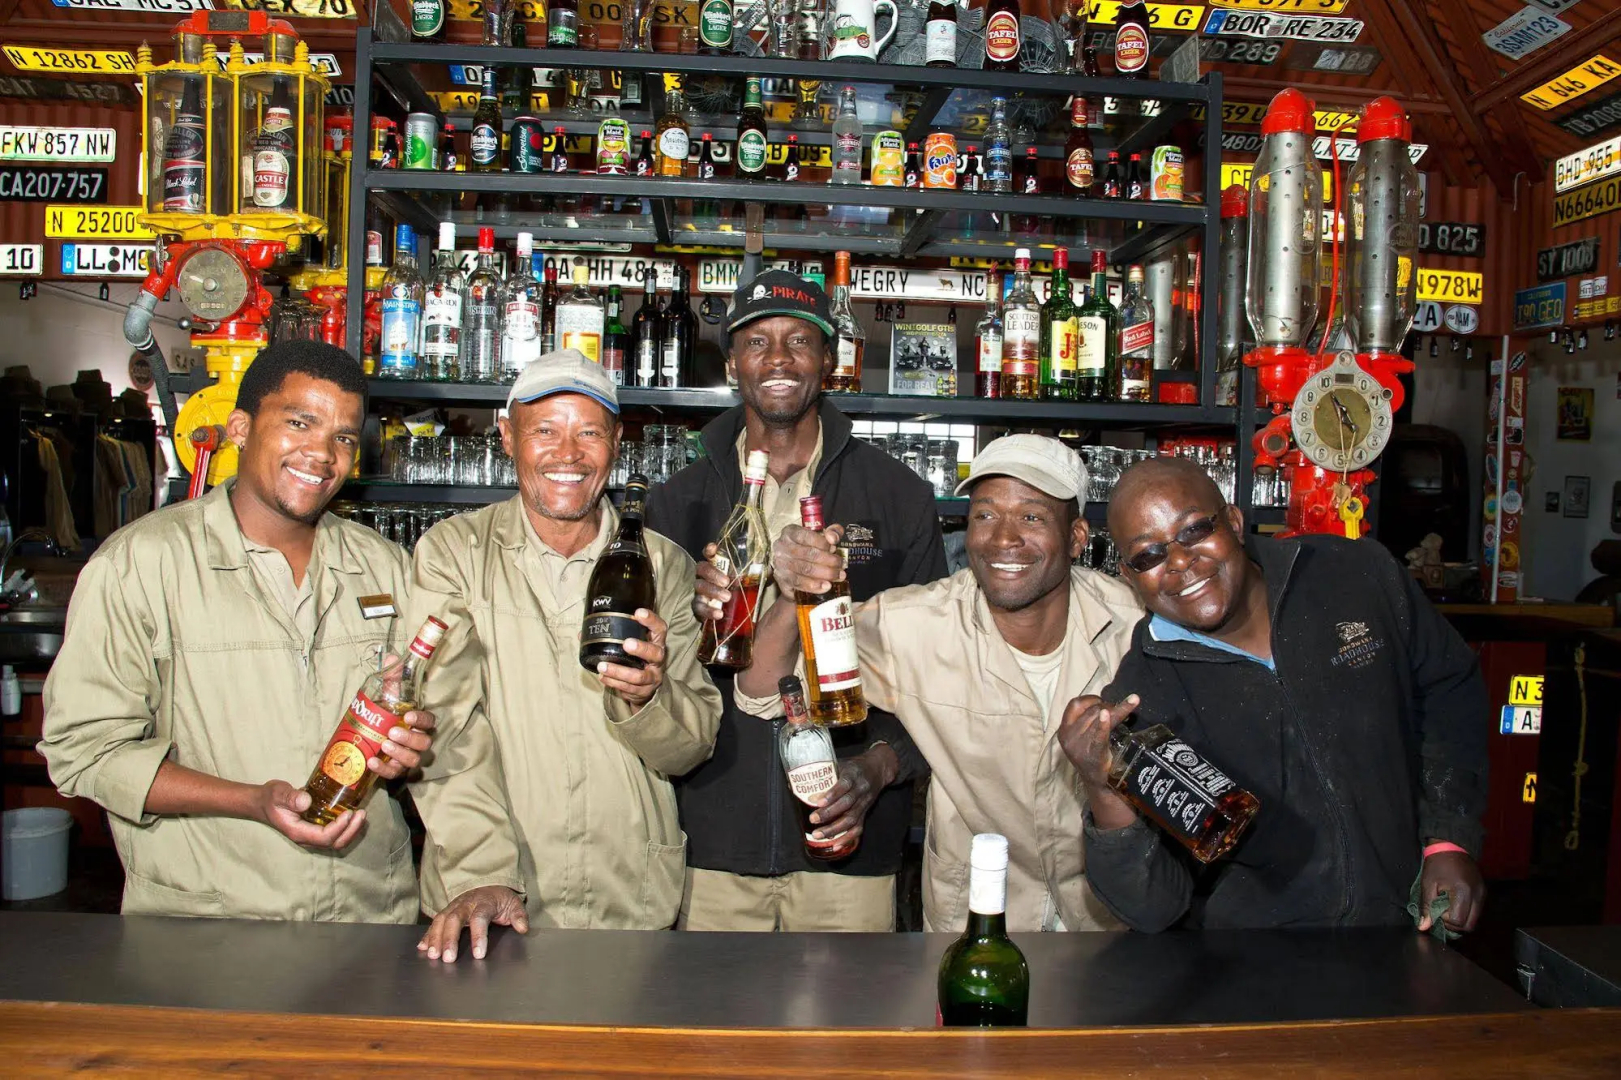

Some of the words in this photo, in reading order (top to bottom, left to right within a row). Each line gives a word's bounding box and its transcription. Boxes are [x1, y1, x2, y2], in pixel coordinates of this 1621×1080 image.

[989, 29, 1016, 39] TAFEL
[1224, 14, 1270, 34] BOR
[1283, 19, 1317, 36] RE
[1316, 21, 1358, 38] 234
[1117, 41, 1145, 50] TAFEL
[1230, 42, 1281, 62] 289
[8, 49, 27, 66] N
[33, 51, 102, 69] 12862
[1548, 77, 1587, 97] 646
[1583, 60, 1620, 79] KA
[2, 131, 38, 154] FKW
[44, 132, 79, 155] 857
[87, 134, 110, 156] NW
[929, 154, 955, 170] Fanta
[1557, 157, 1581, 186] BHD
[1588, 145, 1613, 175] 955
[255, 174, 284, 184] CASTLE
[52, 210, 63, 233] N
[77, 211, 135, 233] 25200
[1437, 225, 1479, 252] 825
[77, 248, 106, 269] LL
[588, 258, 614, 281] HH
[962, 274, 984, 297] NC
[772, 285, 817, 308] PIRATE
[895, 323, 911, 331] WIN
[1123, 333, 1136, 343] Red
[1136, 328, 1152, 340] Label
[897, 380, 914, 390] FOR
[914, 381, 935, 390] REAL
[593, 597, 612, 607] KWV
[589, 623, 610, 635] TEN
[1515, 681, 1528, 700] N
[1521, 710, 1533, 731] A
[790, 764, 833, 783] SOUTHERN
[795, 776, 834, 794] COMFORT
